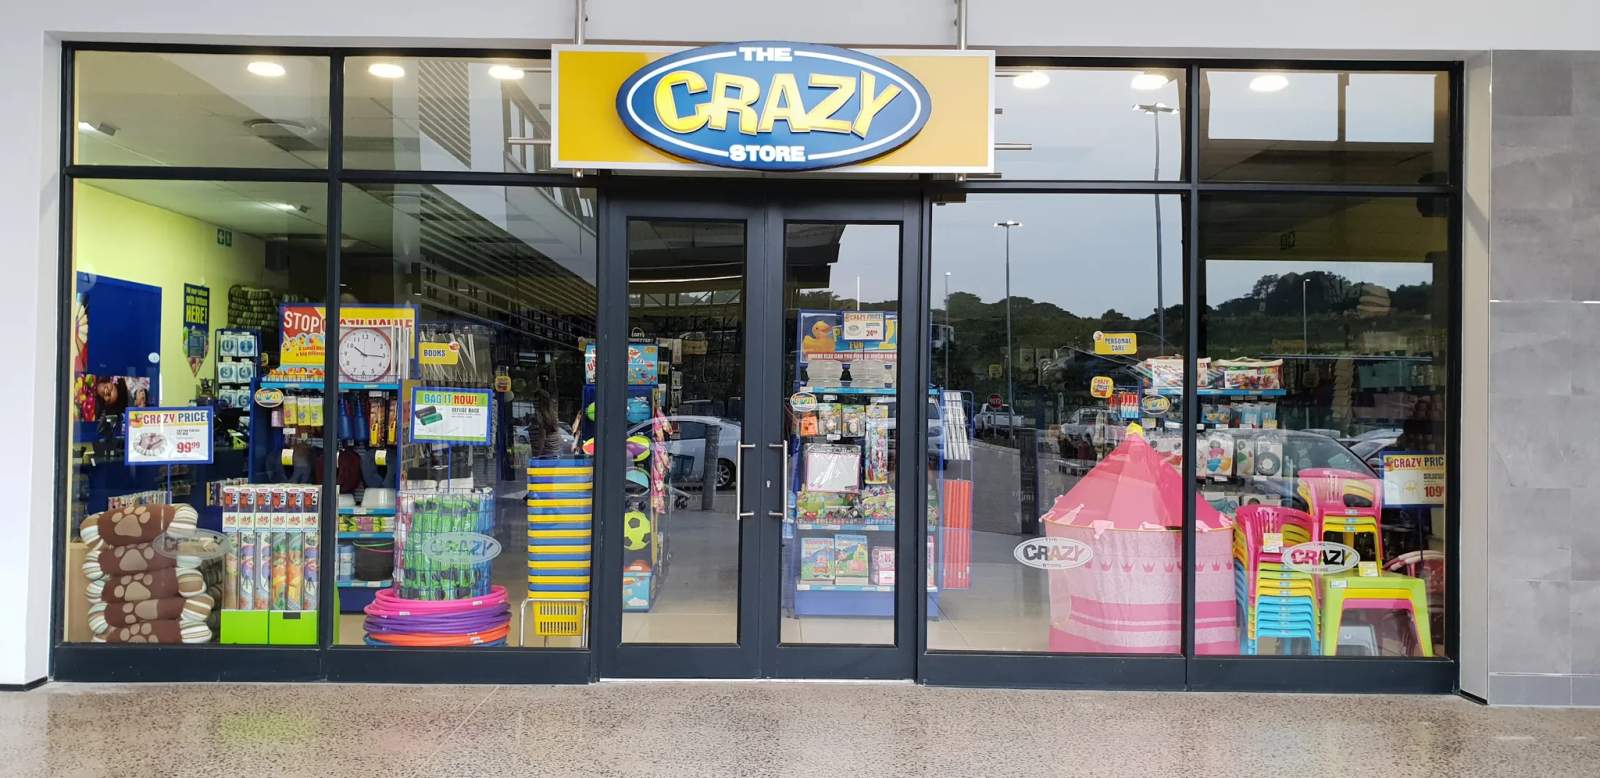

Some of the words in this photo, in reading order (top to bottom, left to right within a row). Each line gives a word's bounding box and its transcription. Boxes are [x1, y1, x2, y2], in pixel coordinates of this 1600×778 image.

[738, 46, 792, 62] THE
[653, 70, 902, 140] CRAZY
[728, 145, 806, 162] STORE
[186, 304, 208, 324] HERE!
[284, 311, 320, 333] STOP
[1105, 337, 1132, 345] PERSONAL
[424, 393, 442, 404] BAG
[444, 394, 452, 404] IT
[454, 394, 477, 405] NOW!
[143, 413, 176, 425] CRAZY
[178, 411, 209, 423] PRICE!
[1393, 457, 1422, 468] CRAZY
[1022, 544, 1086, 562] CRAZY
